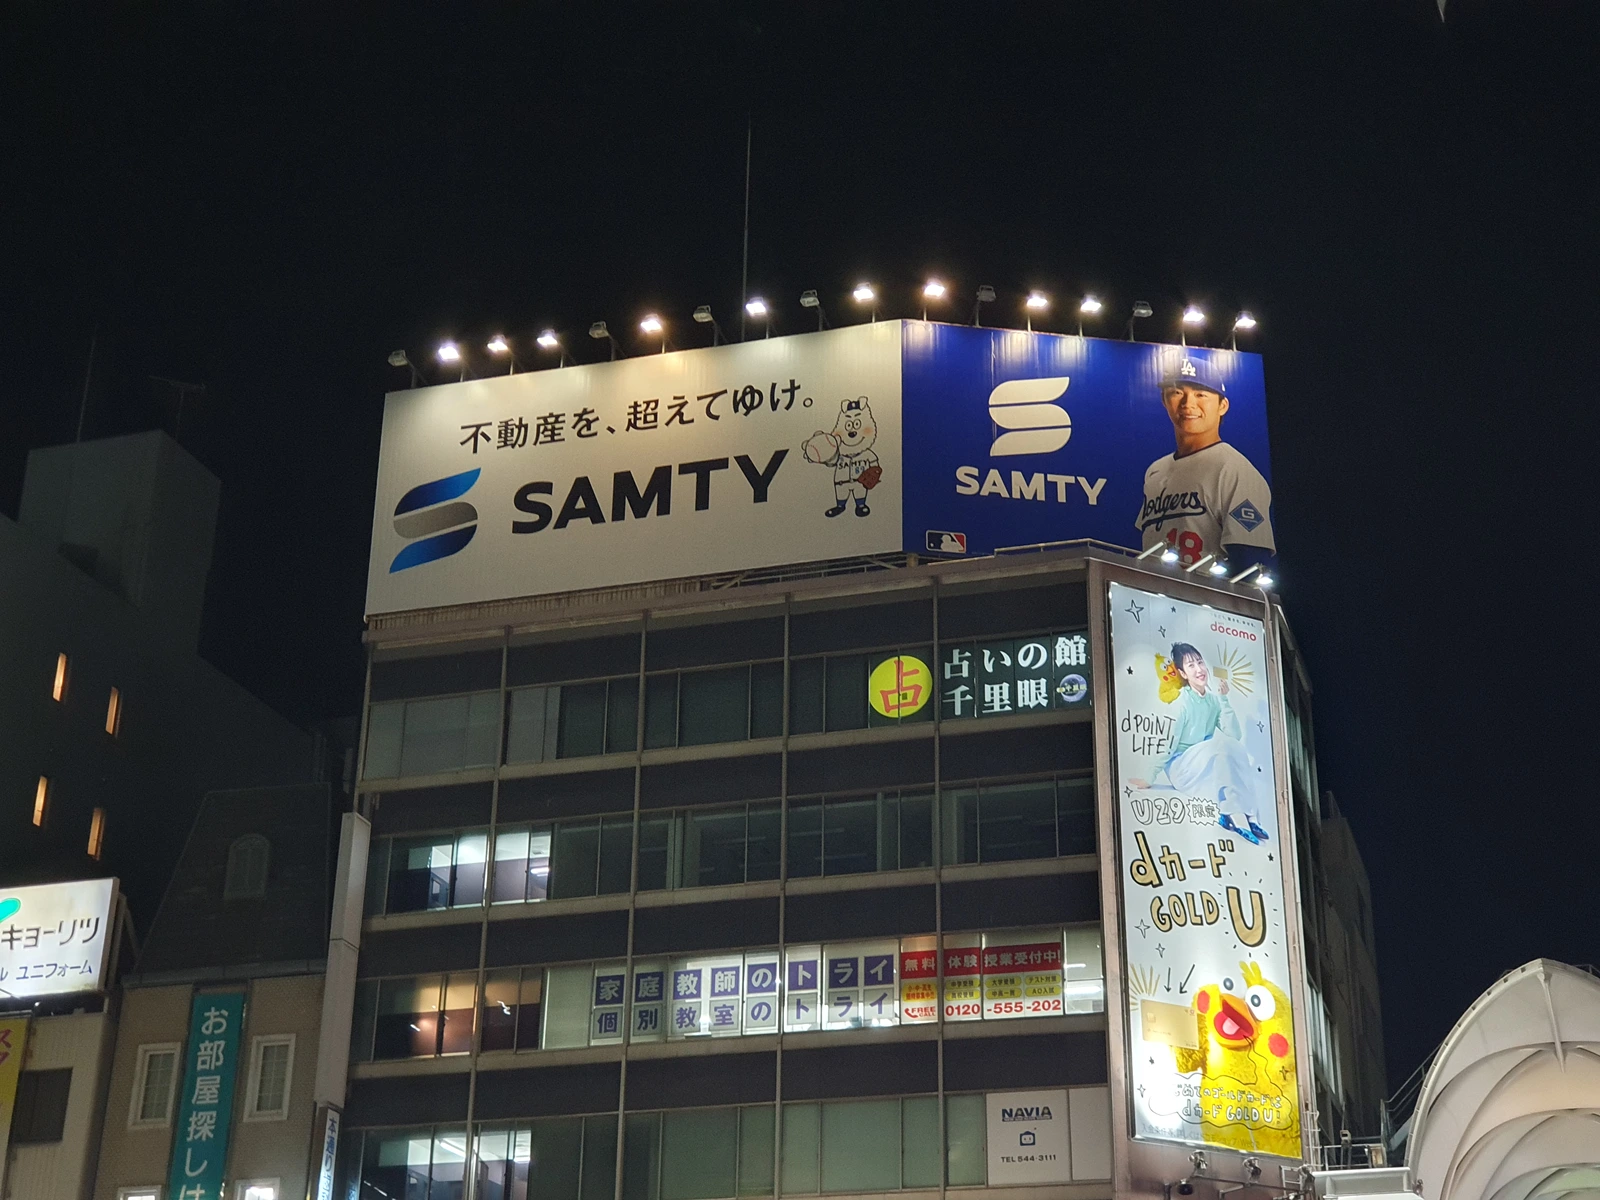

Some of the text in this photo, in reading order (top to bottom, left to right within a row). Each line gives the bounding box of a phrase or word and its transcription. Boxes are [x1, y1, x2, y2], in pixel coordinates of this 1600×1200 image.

[459, 378, 814, 455] 不動産を、超えてゆけ。
[511, 448, 790, 535] SAMTY
[955, 465, 1107, 506] SAMTY
[1210, 621, 1257, 642] docomo
[944, 634, 1087, 680] 占いの館
[879, 659, 923, 714] 占
[942, 677, 1049, 716] 千里眼
[1132, 735, 1175, 756] LIFE!
[1130, 830, 1235, 889] dカード
[1, 917, 100, 951] キョーリツ
[1149, 886, 1267, 948] GOLD U
[16, 959, 92, 980] ユニフォーム
[598, 958, 889, 1002] 家庭教師のトライ
[597, 991, 888, 1034] 個別教室のトライ
[911, 1006, 936, 1014] FREE
[1001, 1106, 1052, 1118] NAVIA
[1226, 1105, 1260, 1123] GOLD
